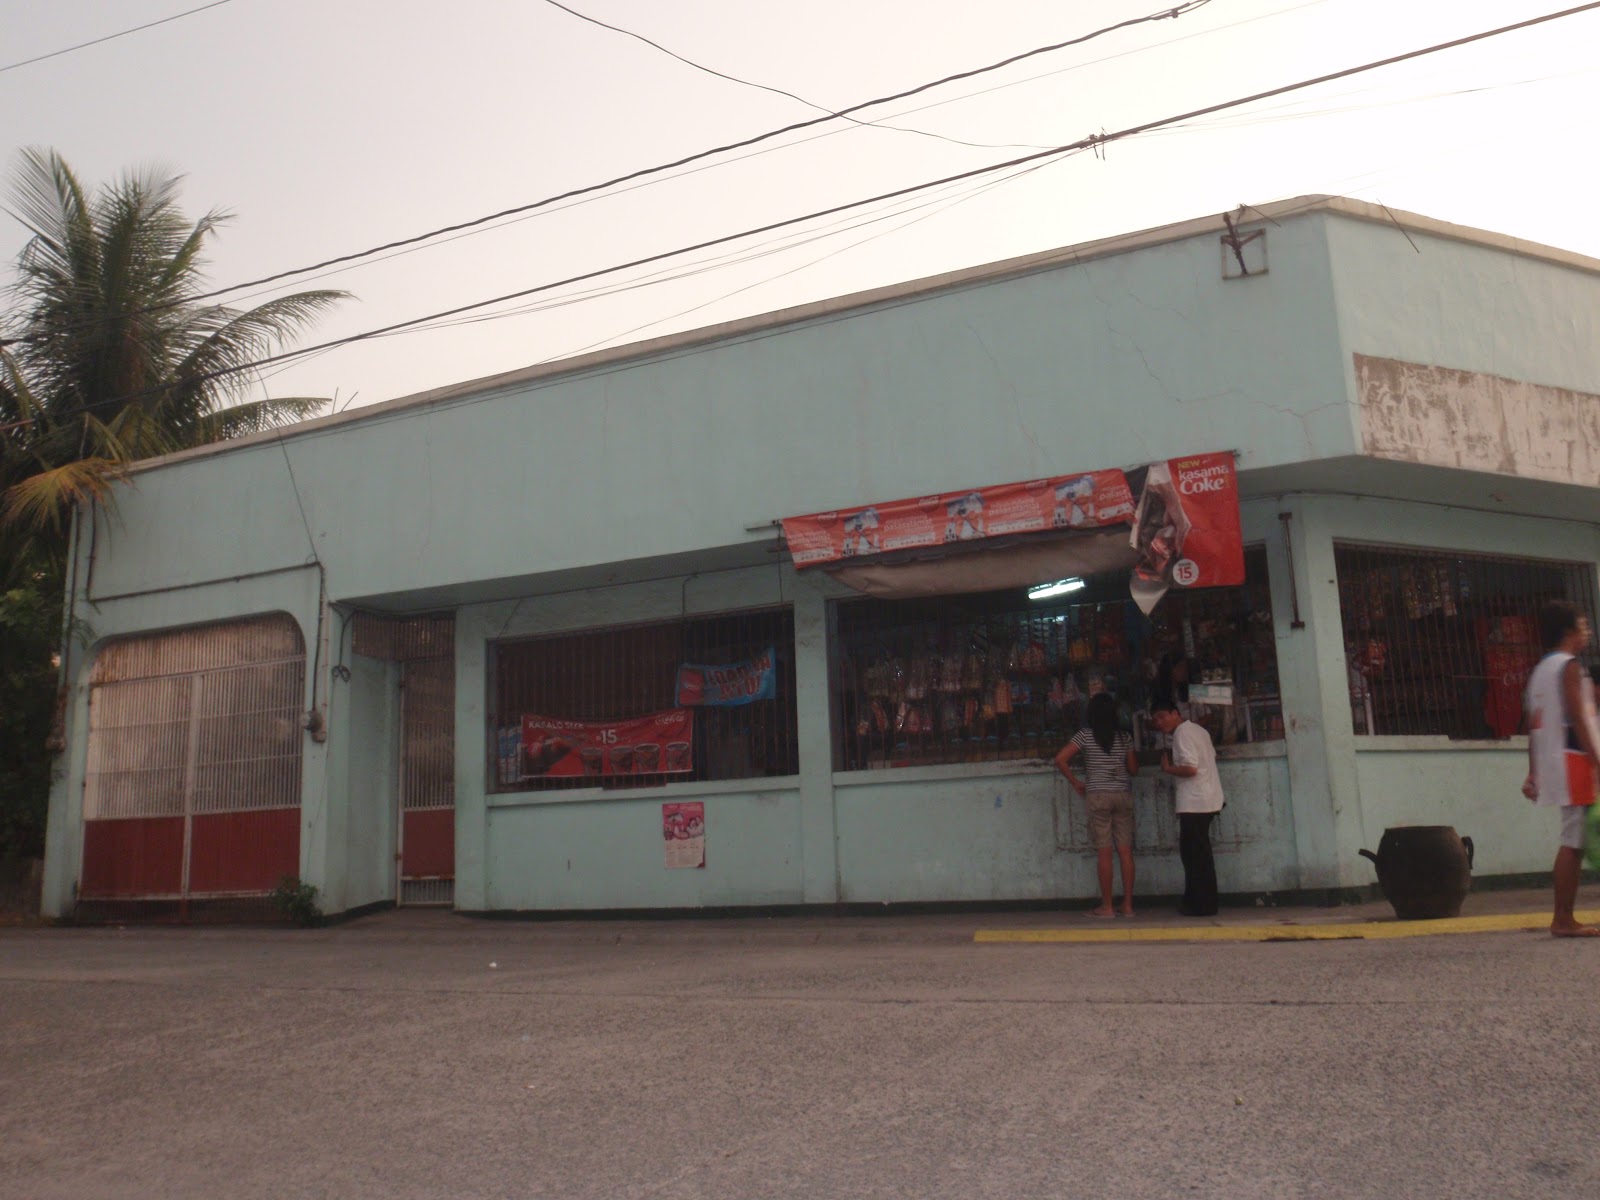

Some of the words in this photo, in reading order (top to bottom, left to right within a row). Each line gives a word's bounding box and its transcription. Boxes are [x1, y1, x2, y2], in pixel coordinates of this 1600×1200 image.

[1177, 459, 1200, 470] NEW
[1178, 464, 1229, 482] kasama
[1177, 566, 1193, 580] 15
